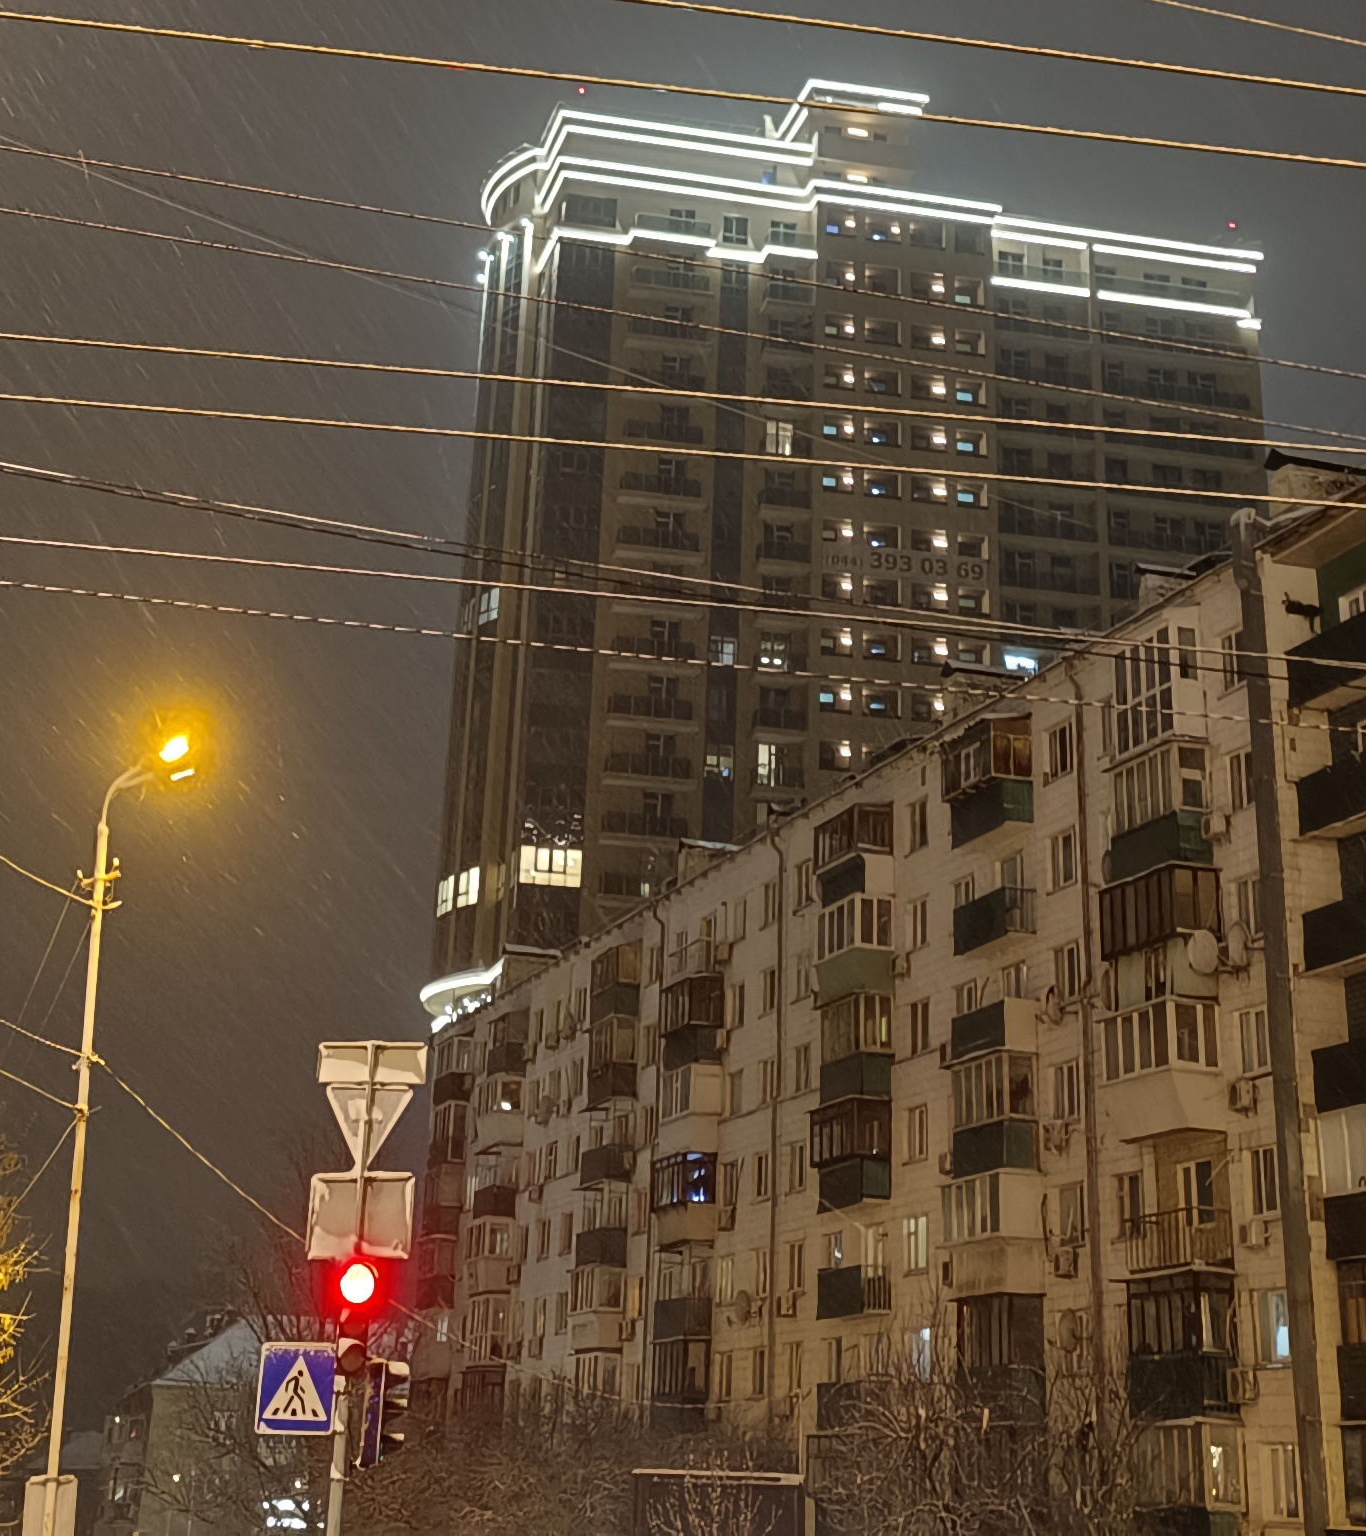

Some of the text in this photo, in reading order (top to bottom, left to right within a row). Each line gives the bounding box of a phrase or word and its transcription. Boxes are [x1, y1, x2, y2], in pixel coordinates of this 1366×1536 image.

[870, 552, 912, 572] 393
[921, 557, 948, 576] 03
[956, 562, 984, 581] 69
